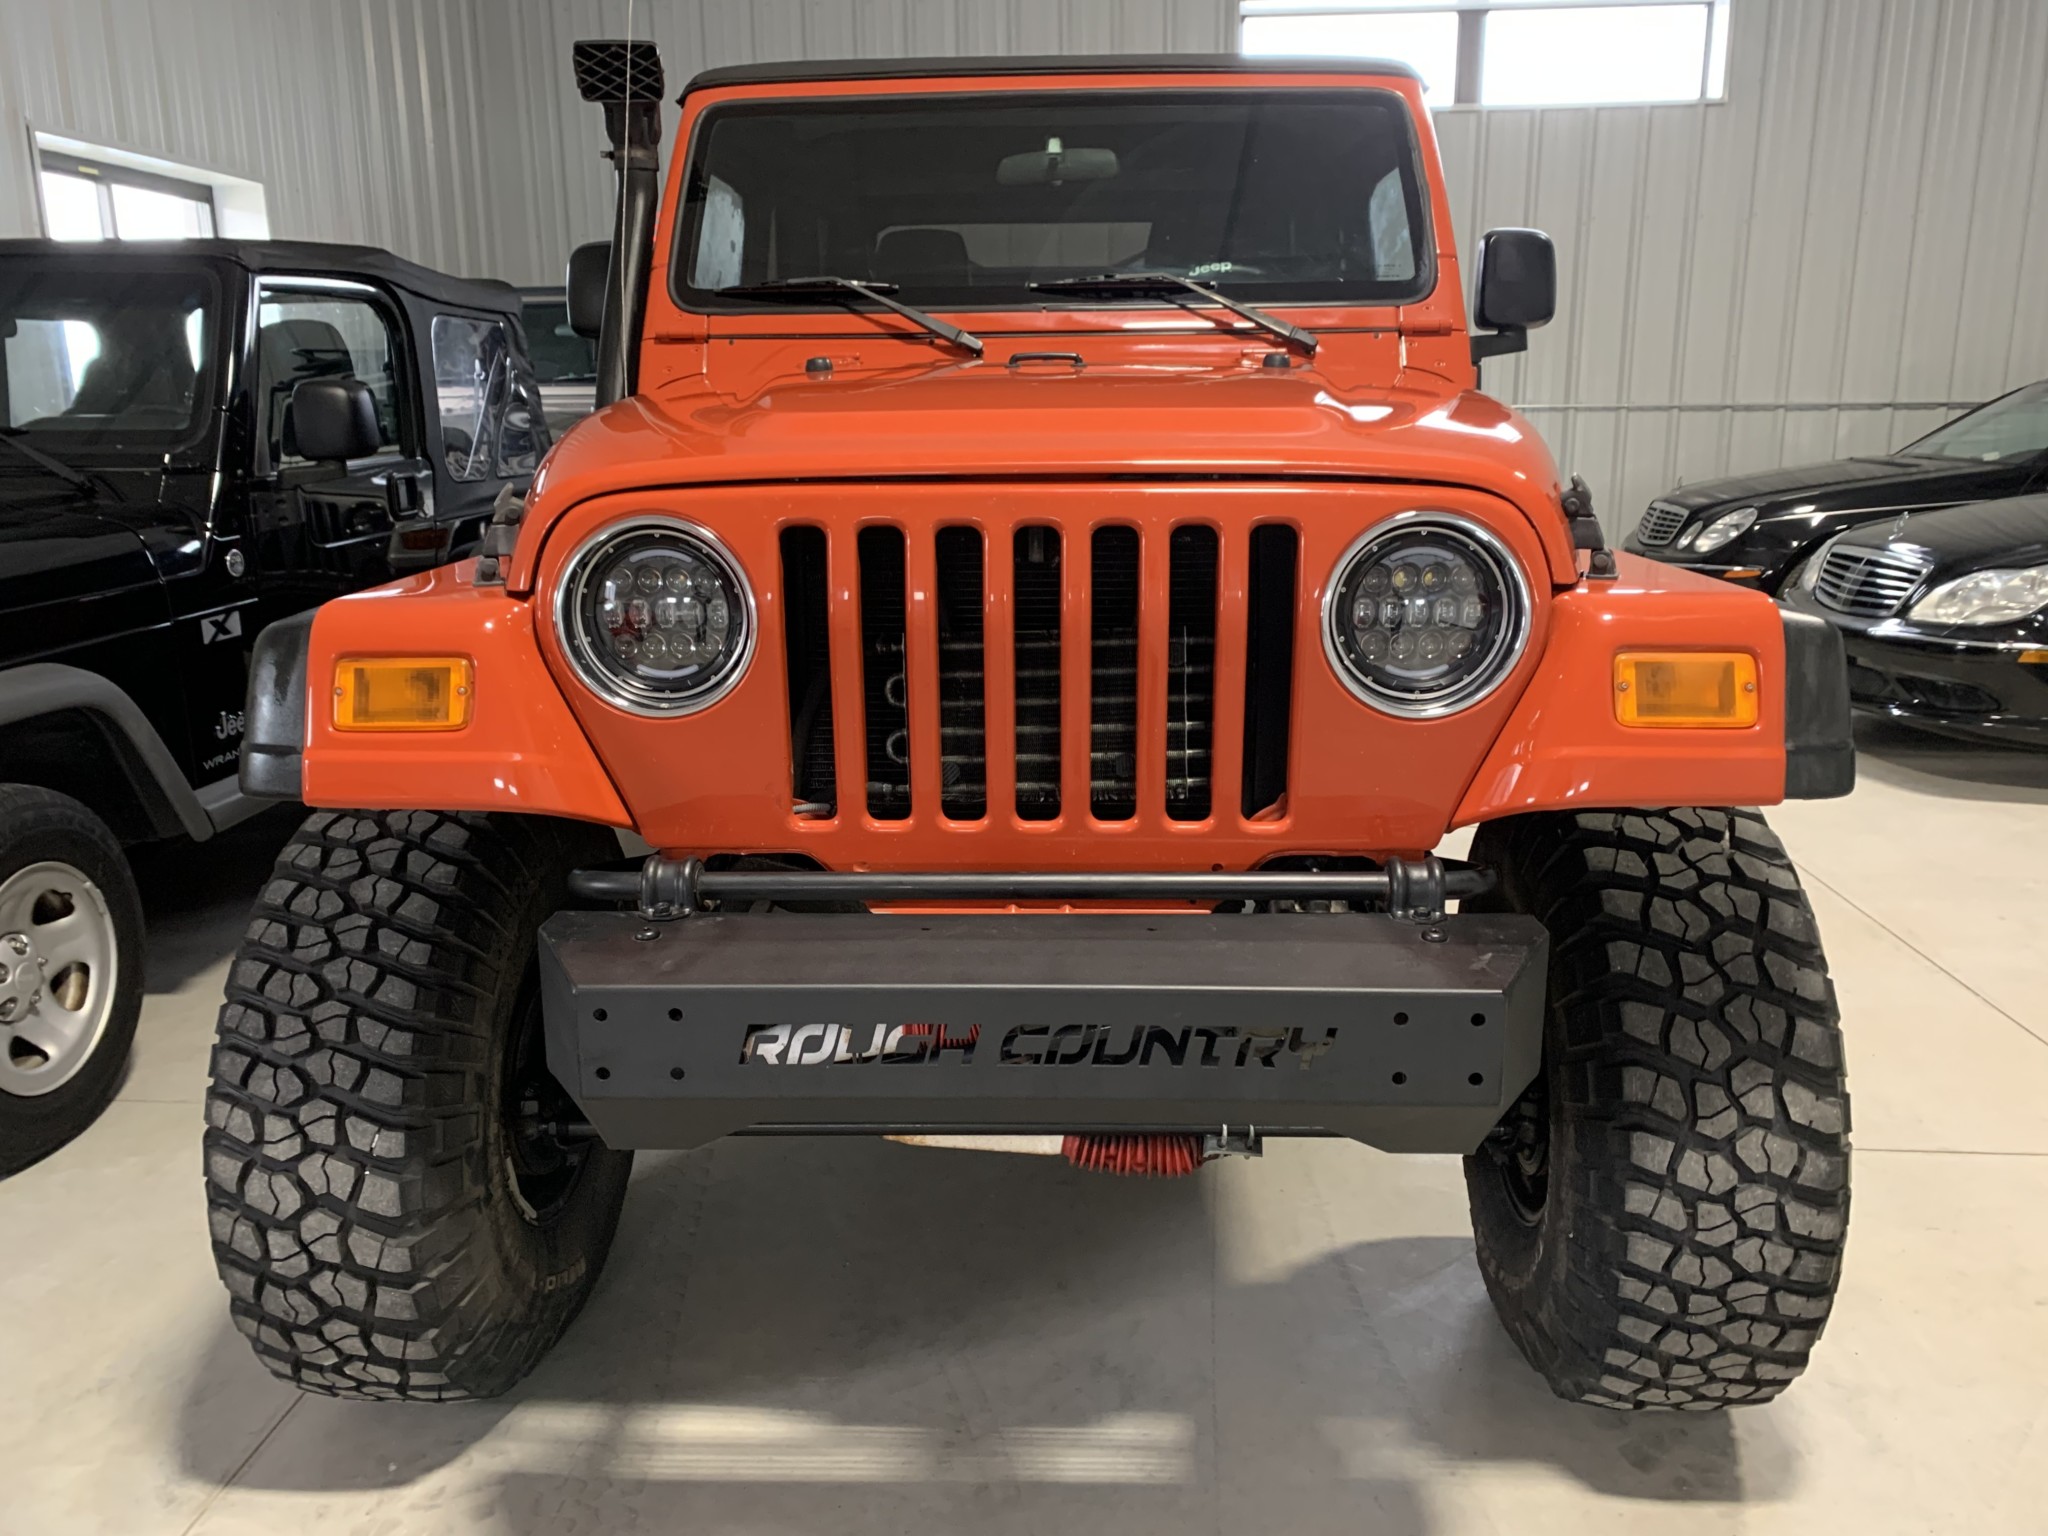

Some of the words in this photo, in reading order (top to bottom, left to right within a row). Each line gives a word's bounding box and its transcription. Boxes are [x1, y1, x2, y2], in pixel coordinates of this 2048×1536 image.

[1188, 261, 1233, 276] Jeep
[215, 710, 246, 739] Jee
[203, 747, 241, 770] WRAN
[738, 1023, 982, 1065] ROUGH
[997, 1023, 1339, 1071] COUNTRY
